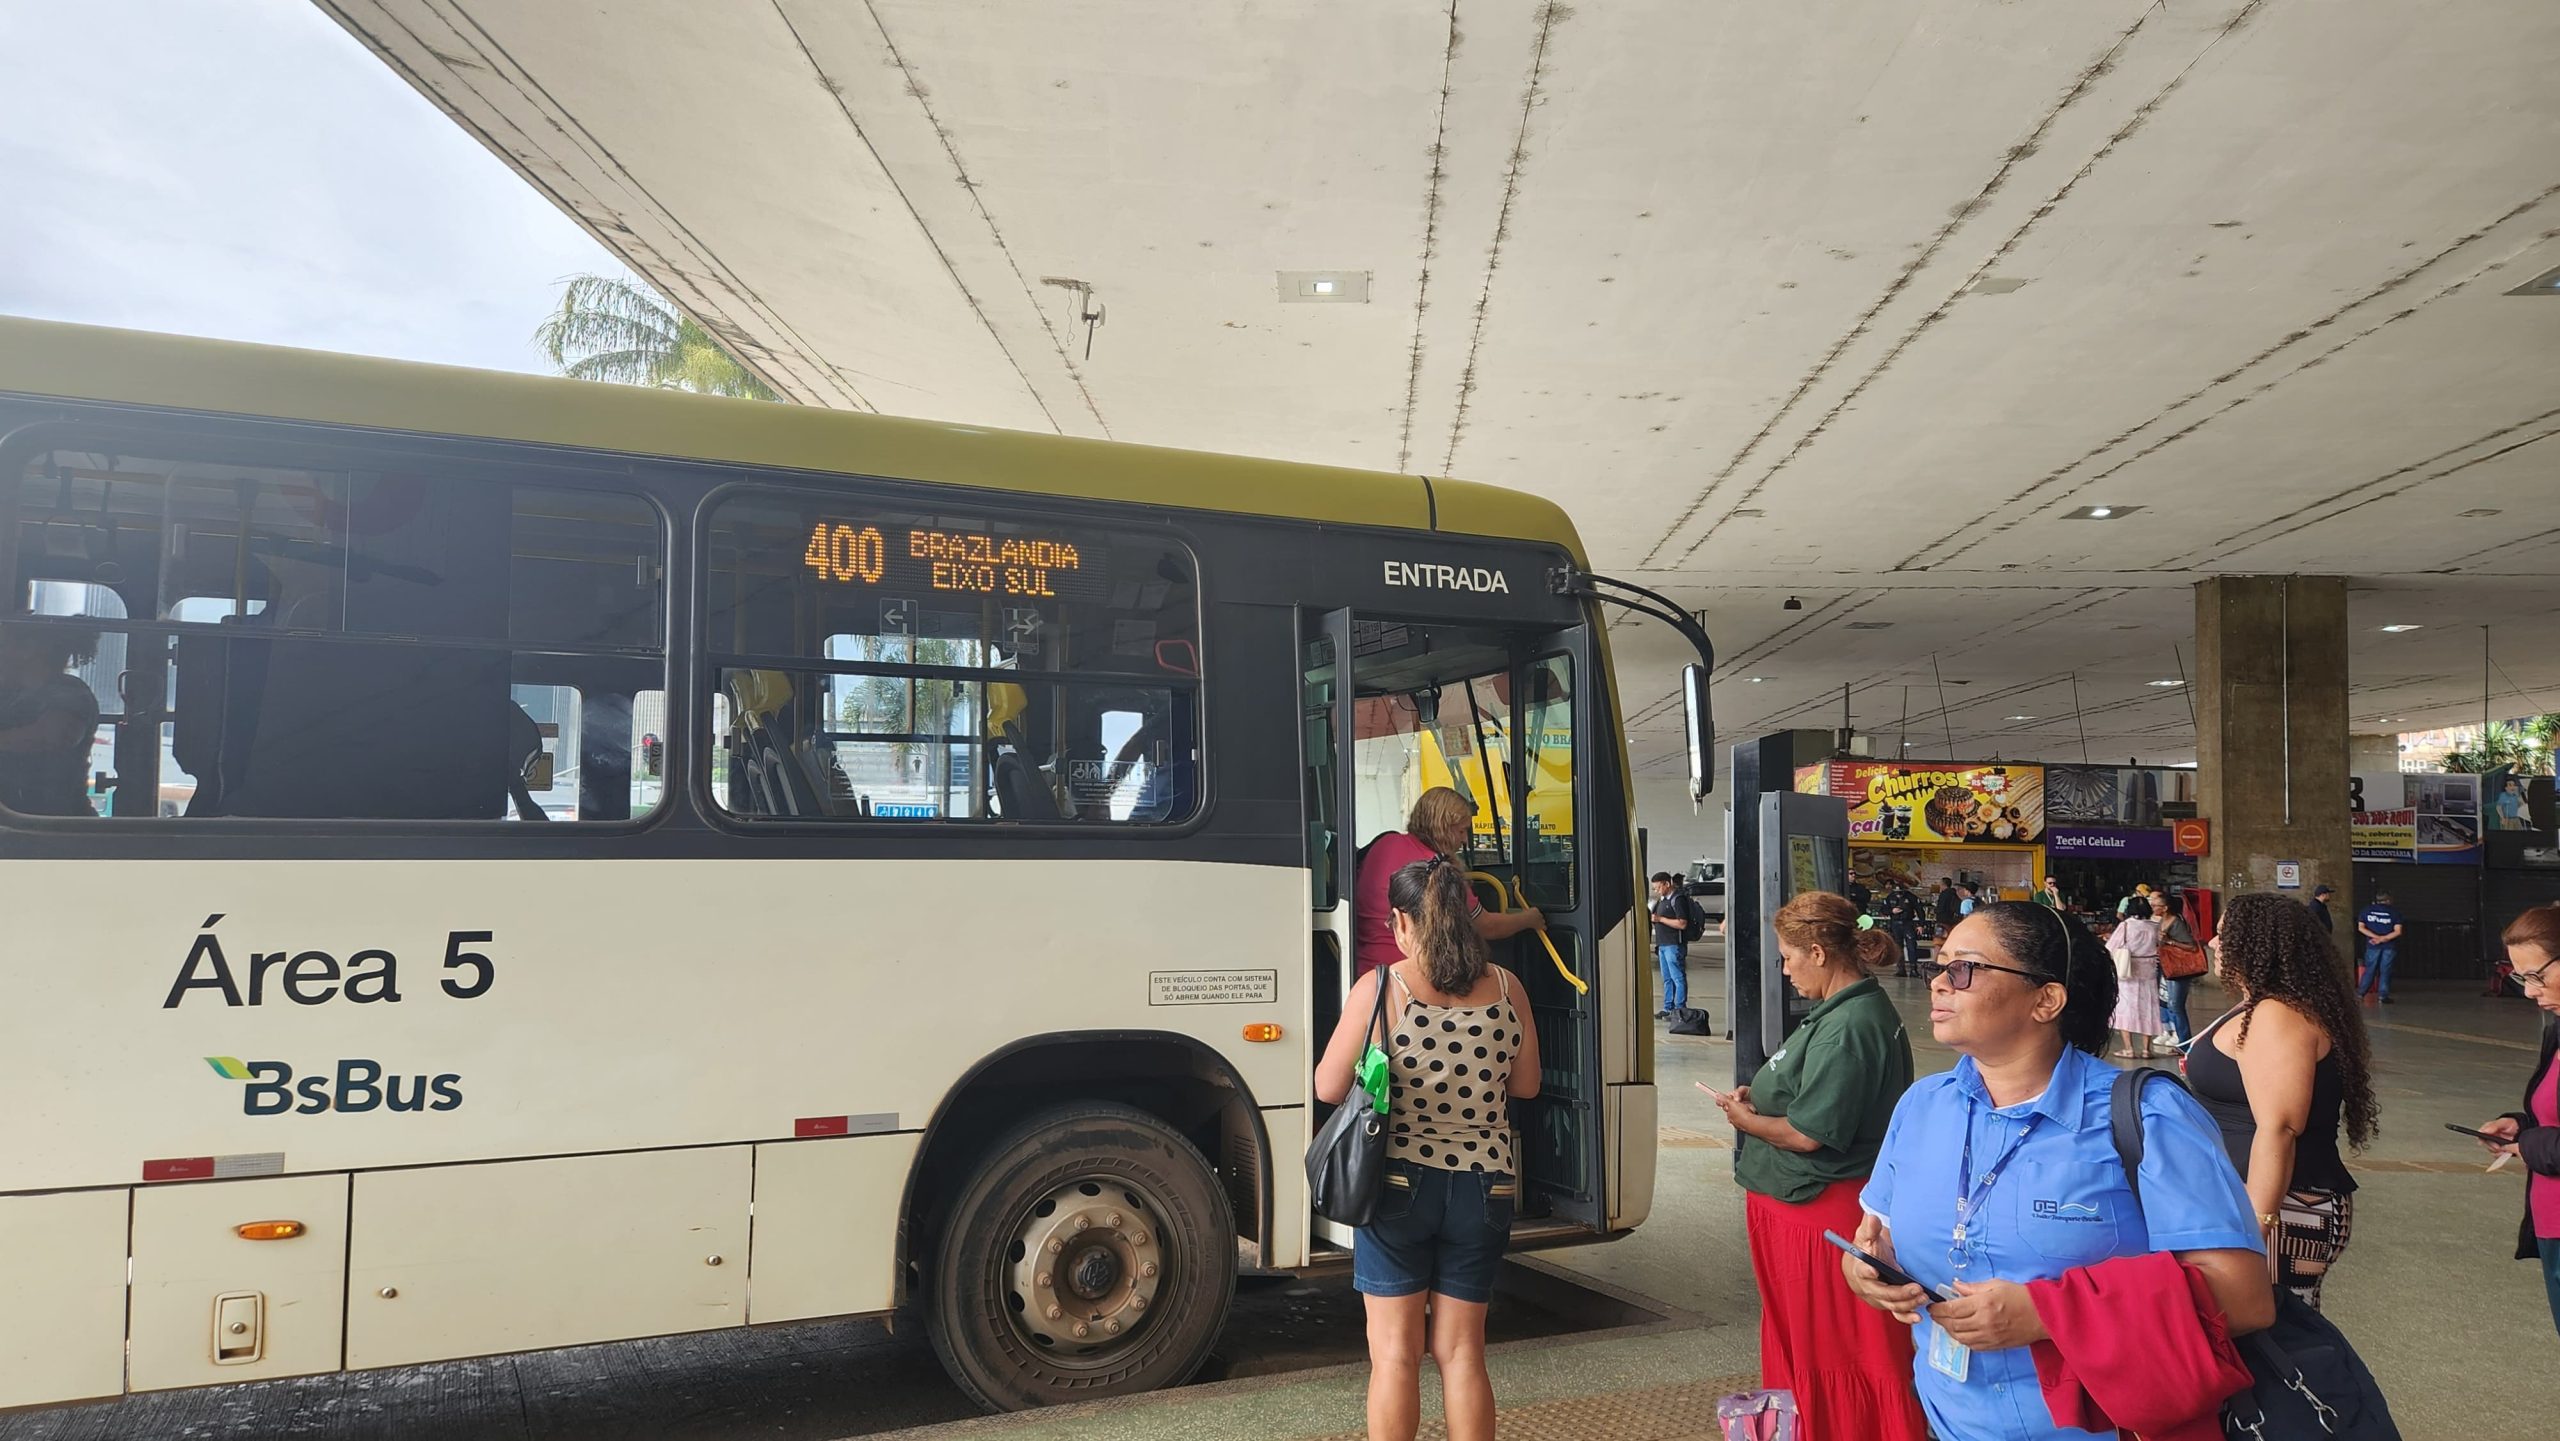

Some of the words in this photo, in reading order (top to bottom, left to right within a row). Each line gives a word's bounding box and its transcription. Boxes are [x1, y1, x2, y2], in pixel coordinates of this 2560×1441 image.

[805, 523, 883, 583] 400
[910, 531, 1079, 569] BRAZLANDIA
[933, 562, 994, 591] EIXO
[1004, 568, 1055, 596] SUL
[1384, 561, 1509, 593] ENTRADA
[1867, 770, 1959, 804] Churros
[1848, 815, 1882, 837] çaí
[2390, 810, 2414, 827] AQUI!
[2056, 835, 2086, 846] Tectel
[2088, 836, 2126, 847] Celular
[163, 913, 401, 1008] Área
[440, 930, 495, 999] 5
[1154, 976, 1171, 984] ESTE
[1173, 975, 1202, 983] VEÍCULO
[1224, 984, 1252, 992] PORTAS,
[244, 1059, 463, 1116] BsBus
